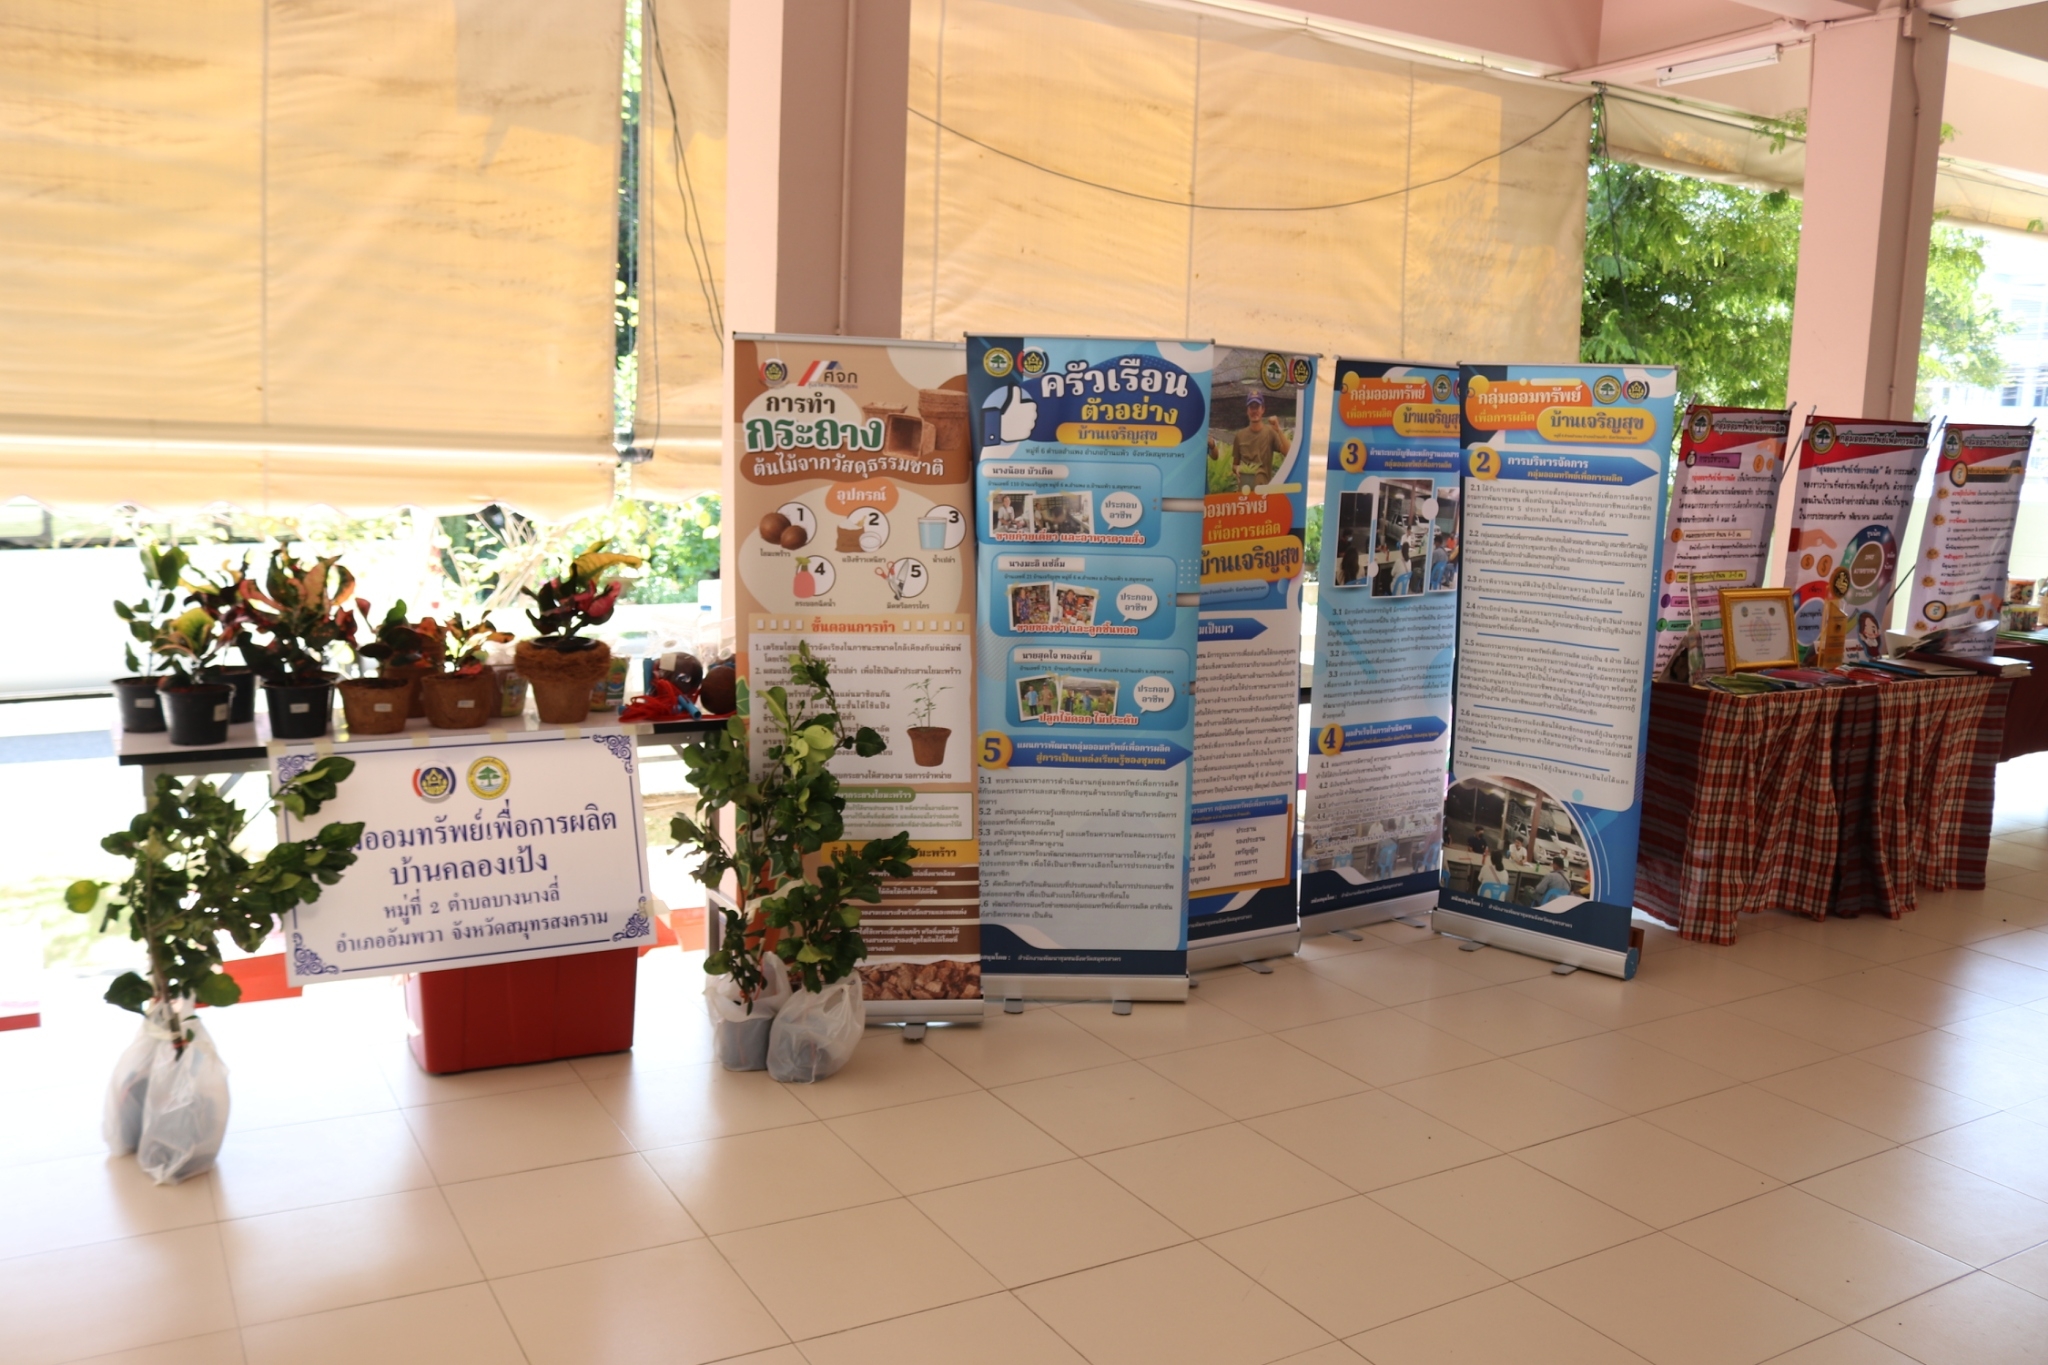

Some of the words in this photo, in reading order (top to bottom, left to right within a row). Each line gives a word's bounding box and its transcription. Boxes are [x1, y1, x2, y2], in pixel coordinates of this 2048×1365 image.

[824, 370, 858, 384] ศจก
[1041, 358, 1188, 397] ครัวเรือน
[765, 392, 836, 414] การทำ
[1350, 383, 1427, 406] กลุ่มออมทรัพย์
[1477, 384, 1584, 409] กลุ่มออมทรัพย์
[1081, 396, 1179, 424] ตัวอย่าง
[1474, 409, 1535, 424] เพื่อการผลิต
[1550, 410, 1645, 436] บ้านเจริญสุข
[746, 417, 883, 450] กระถาง
[1077, 425, 1158, 445] บ้านเจริญสุข
[1838, 428, 1926, 448] กลุ่มออมทรัพย์เพื่อการผลิต
[1346, 443, 1359, 465] 3
[1476, 452, 1490, 473] 2
[1507, 455, 1589, 469] การบริหารจัดการ
[753, 452, 944, 479] ต้นไม้จากวัสดุธรรมชาติ
[1527, 469, 1623, 483] กลุ่มออมทรัพย์เพื่อการผลิต
[836, 486, 887, 504] อุปกรณ์
[796, 508, 804, 521] 1
[1104, 501, 1138, 511] ประกอบ
[868, 512, 880, 526] 2
[948, 510, 960, 524] 3
[1208, 520, 1282, 542] เพื่อการผลิต
[1469, 529, 1479, 537] 2.2
[814, 562, 826, 576] 4
[1200, 545, 1300, 576] บ้านเจริญสุข
[911, 564, 922, 578] 5
[1467, 575, 1477, 583] 2.3
[1119, 593, 1153, 602] ประกอบ
[1466, 602, 1476, 610] 2.4
[811, 616, 896, 633] ขั้นตอนการทำ
[1464, 639, 1475, 647] 2.5
[1137, 685, 1170, 694] ประกอบ
[1460, 708, 1470, 717] 2.6
[1324, 727, 1336, 749] 4
[983, 738, 1002, 762] 5
[1458, 750, 1469, 759] 2.7
[390, 844, 549, 886] บ้านคลองเป้ง
[384, 888, 422, 926] หมู่ที่
[430, 901, 440, 915] 2
[449, 876, 561, 912] ตำบลบางนางลี่
[336, 927, 444, 953] อำเภออัมพวา
[452, 909, 609, 941] จังหวัดสมุทรสงคราม
